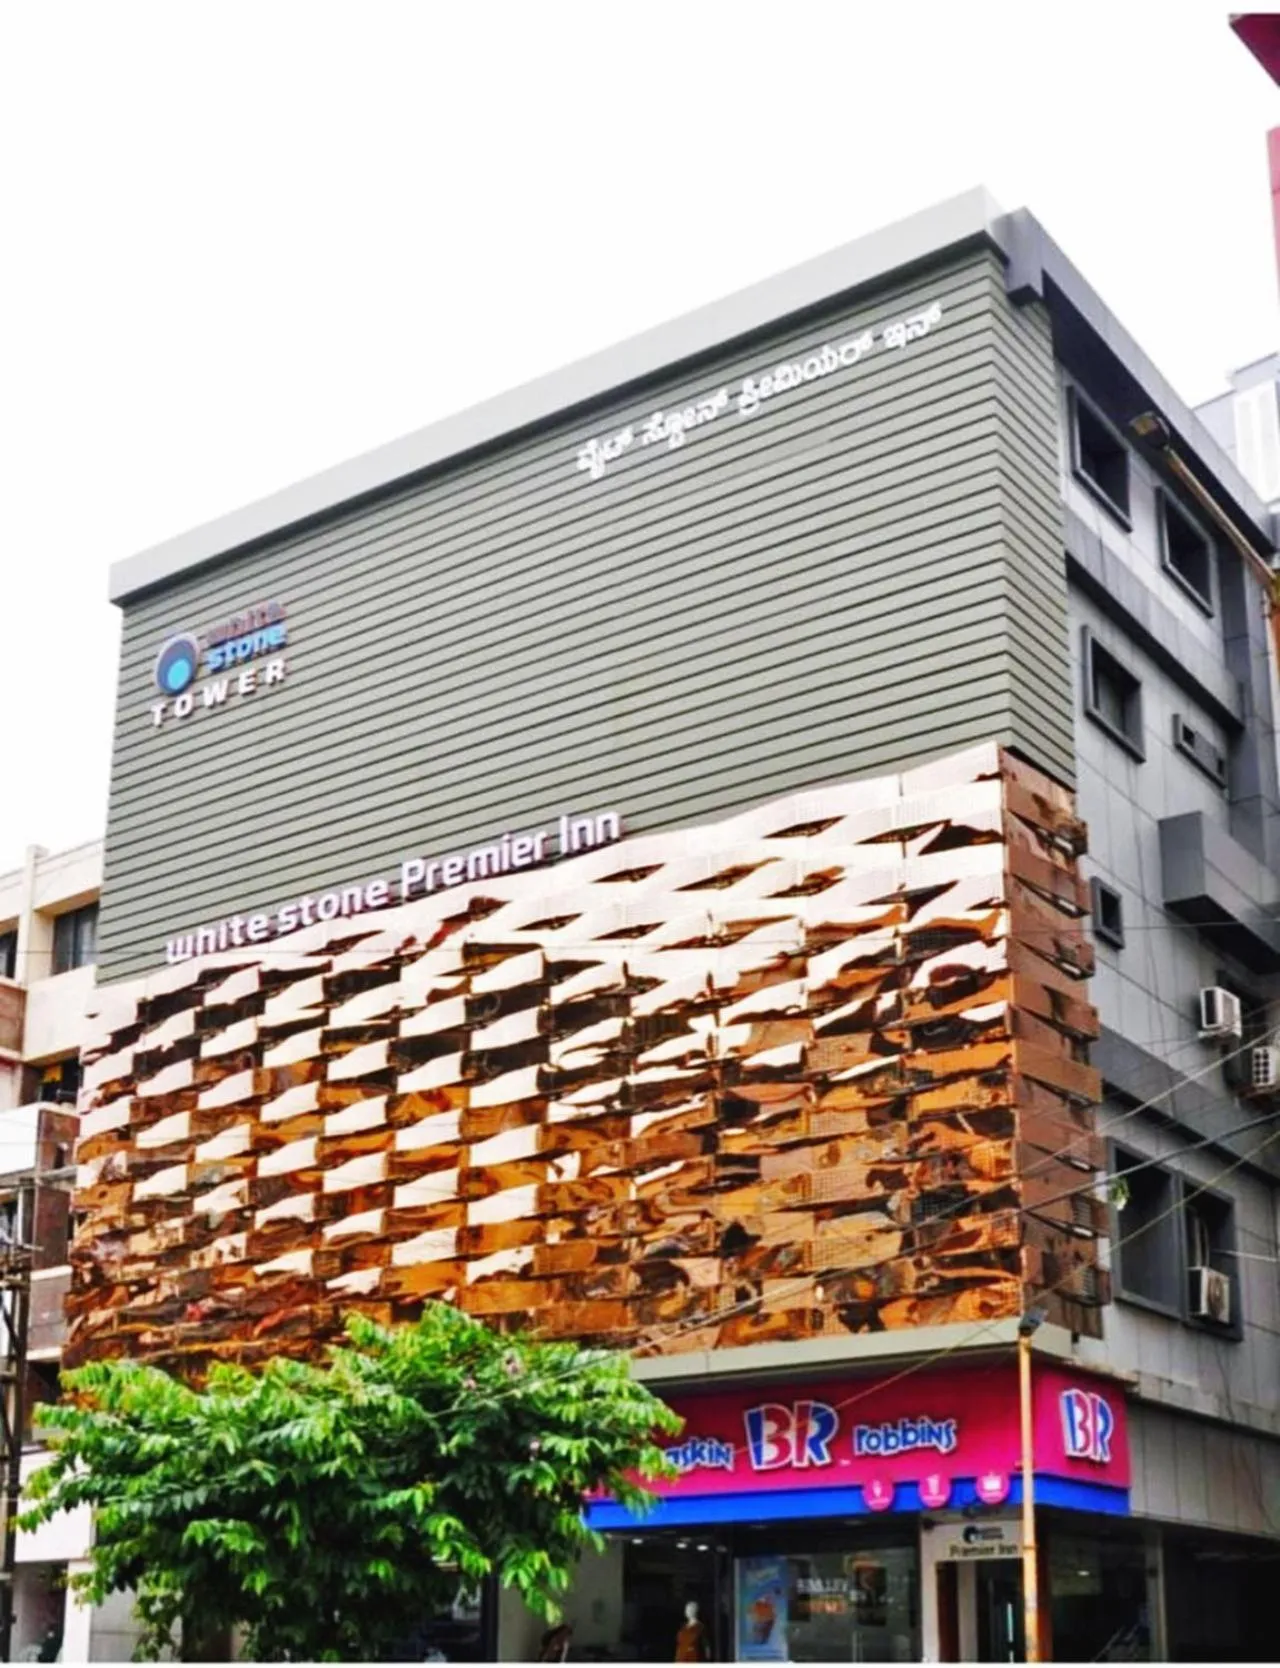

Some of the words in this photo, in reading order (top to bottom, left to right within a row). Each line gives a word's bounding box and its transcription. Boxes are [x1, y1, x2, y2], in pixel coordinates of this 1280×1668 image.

[883, 301, 942, 347] ಇನ್
[205, 622, 288, 672] stone
[151, 658, 286, 726] TOWER
[166, 912, 269, 964] white
[277, 878, 389, 934] stone
[401, 830, 548, 897] Premier
[559, 811, 619, 854] Inn
[744, 1400, 840, 1471] BR
[1059, 1388, 1114, 1463] BR
